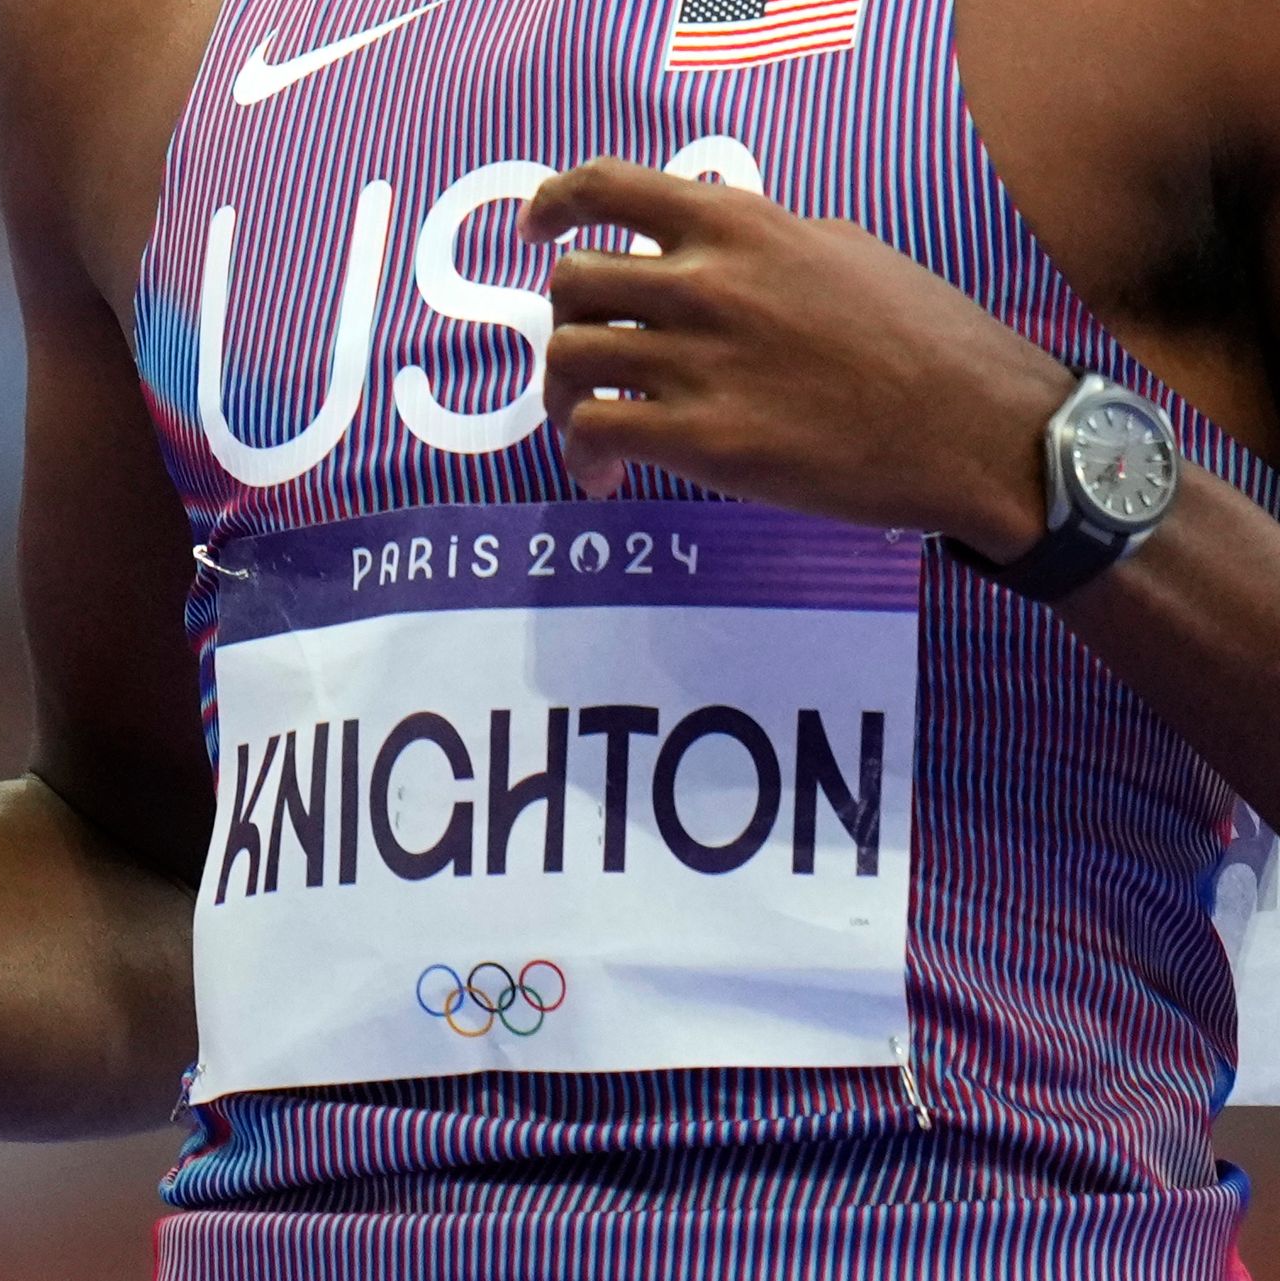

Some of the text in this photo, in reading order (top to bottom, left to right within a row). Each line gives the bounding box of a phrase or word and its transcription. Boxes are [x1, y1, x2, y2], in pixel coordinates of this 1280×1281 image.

[198, 134, 764, 488] US
[527, 531, 699, 576] 2024
[213, 705, 885, 906] KNIGHTON
